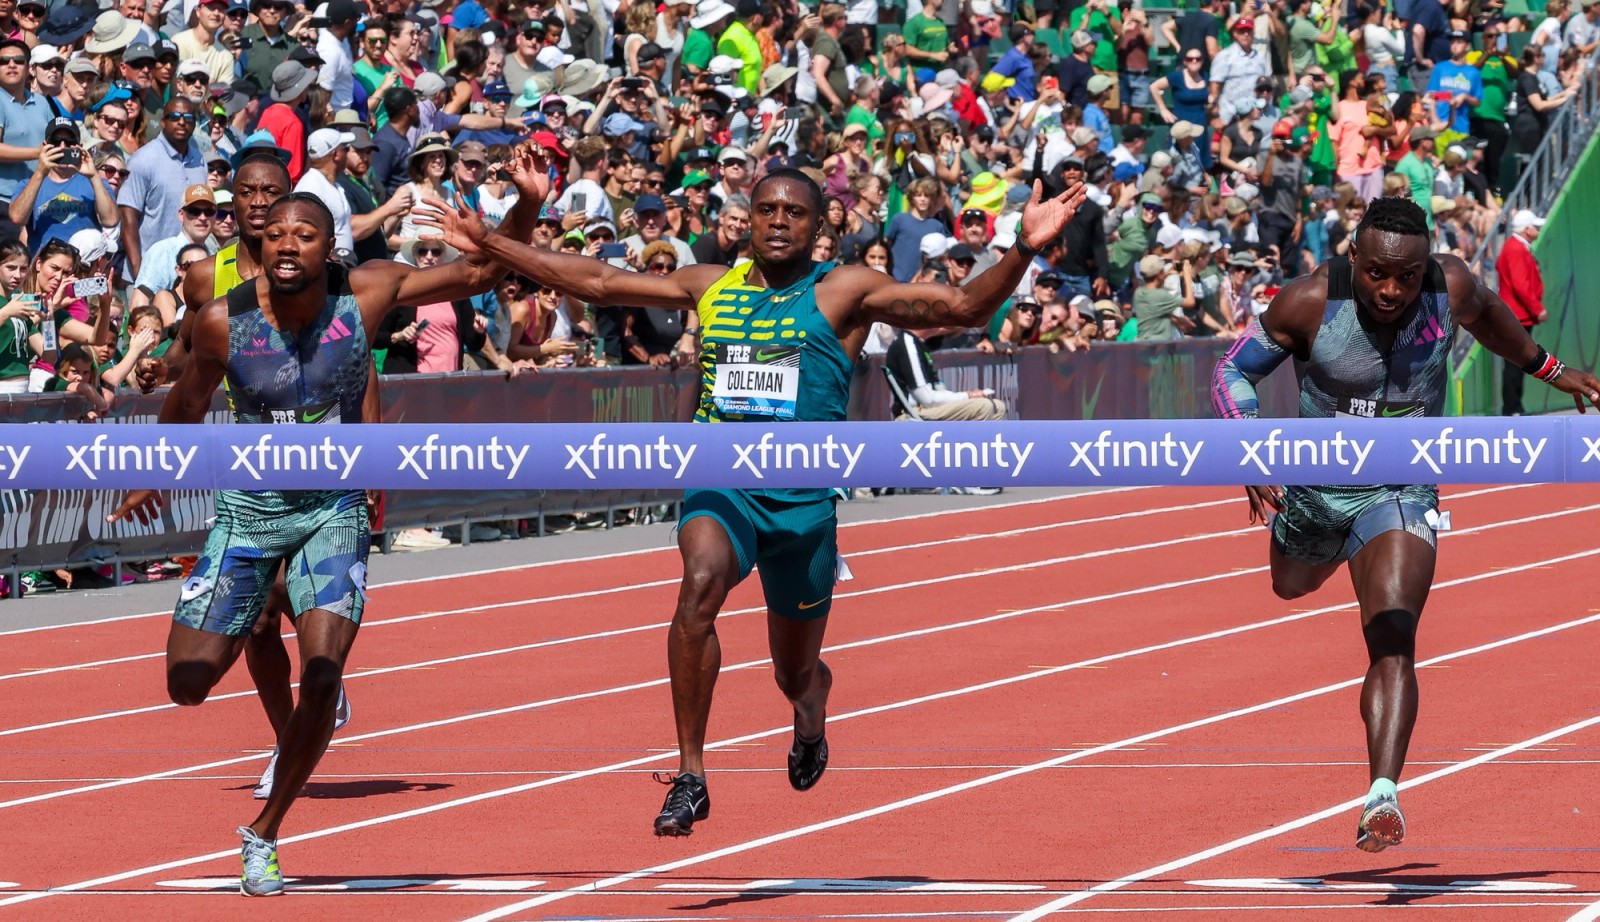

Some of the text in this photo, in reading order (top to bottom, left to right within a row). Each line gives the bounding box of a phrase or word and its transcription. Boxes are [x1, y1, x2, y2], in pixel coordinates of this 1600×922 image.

[727, 345, 751, 363] PRE
[727, 370, 784, 393] COLEMAN
[271, 410, 296, 424] PRE
[1349, 398, 1377, 417] PRE
[66, 434, 197, 480] xfinity
[231, 434, 362, 480] xfinity
[398, 434, 529, 480] xfinity
[565, 433, 697, 479] xfinity
[732, 432, 865, 479] xfinity
[901, 431, 1034, 478] xfinity
[1070, 430, 1204, 477] xfinity
[1240, 428, 1375, 476] xfinity
[1411, 427, 1547, 474] xfinity
